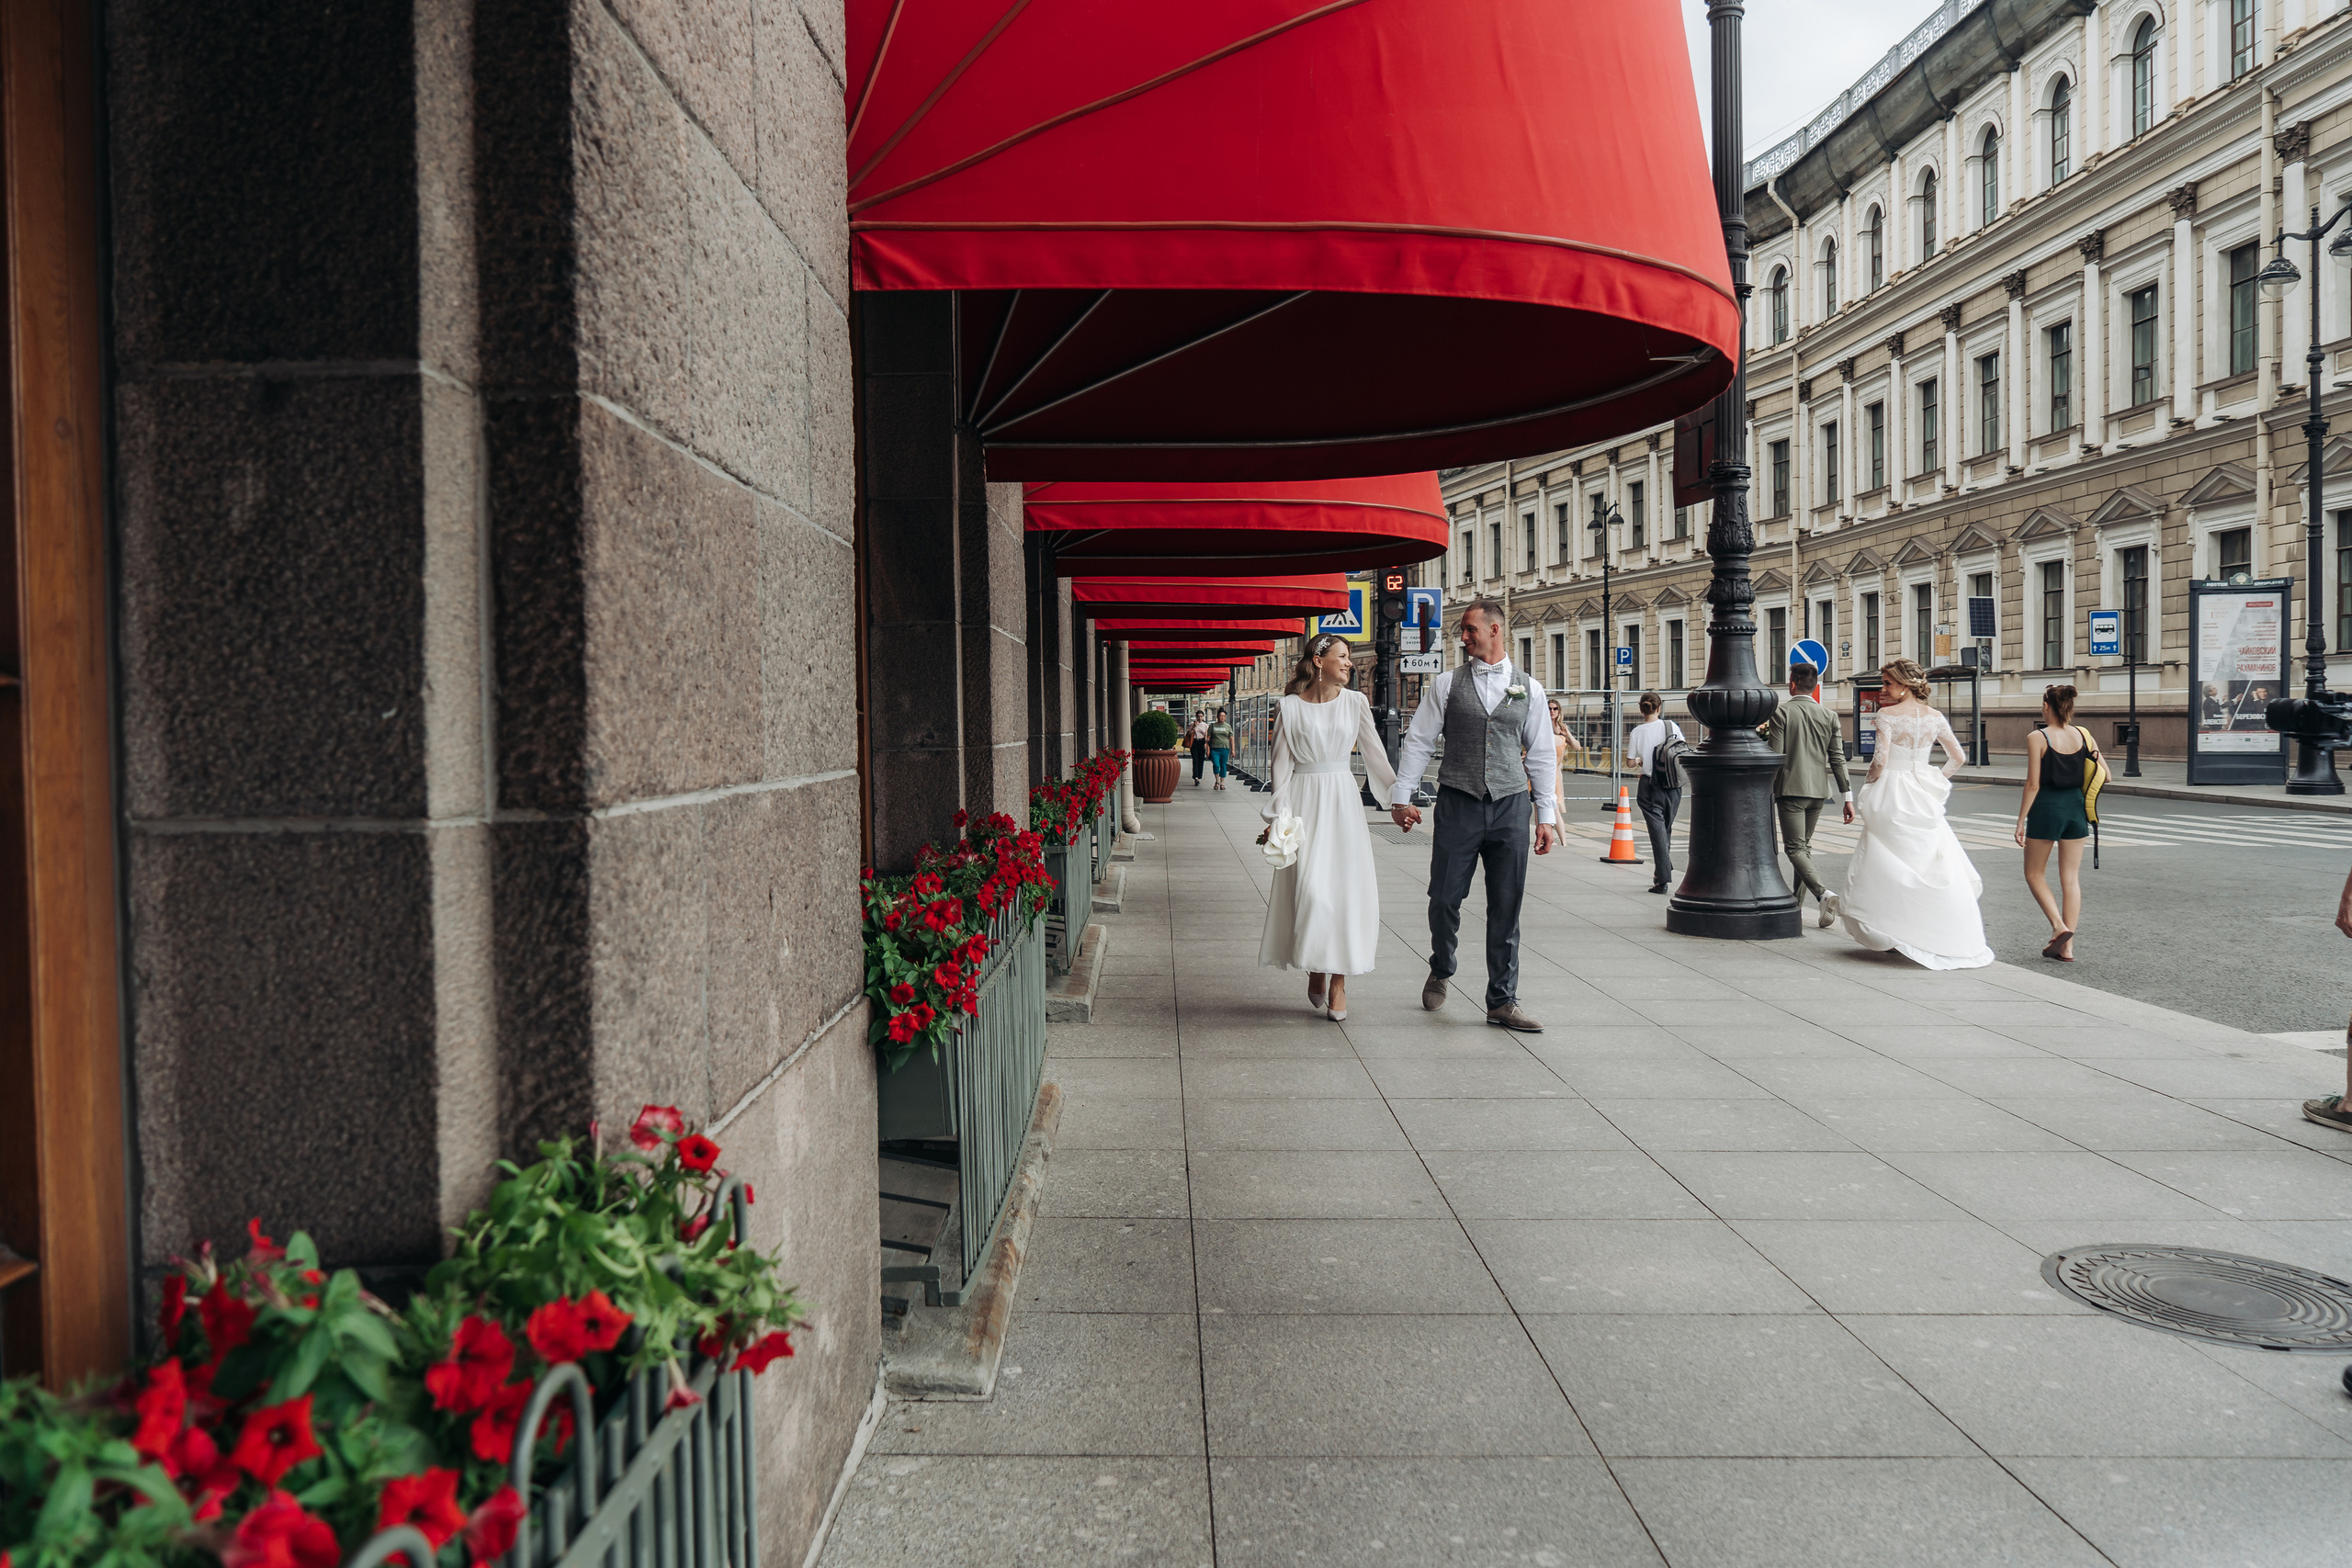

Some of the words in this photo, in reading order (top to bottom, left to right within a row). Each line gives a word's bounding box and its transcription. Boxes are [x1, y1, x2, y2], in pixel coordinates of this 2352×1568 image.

[1386, 575, 1403, 590] 62
[1413, 592, 1434, 624] P
[1620, 649, 1630, 663] P
[2238, 645, 2277, 655] ЧАЙКОВСКИЙ
[1411, 659, 1430, 667] 60м
[2236, 663, 2277, 672] РАХМАНИНОВ
